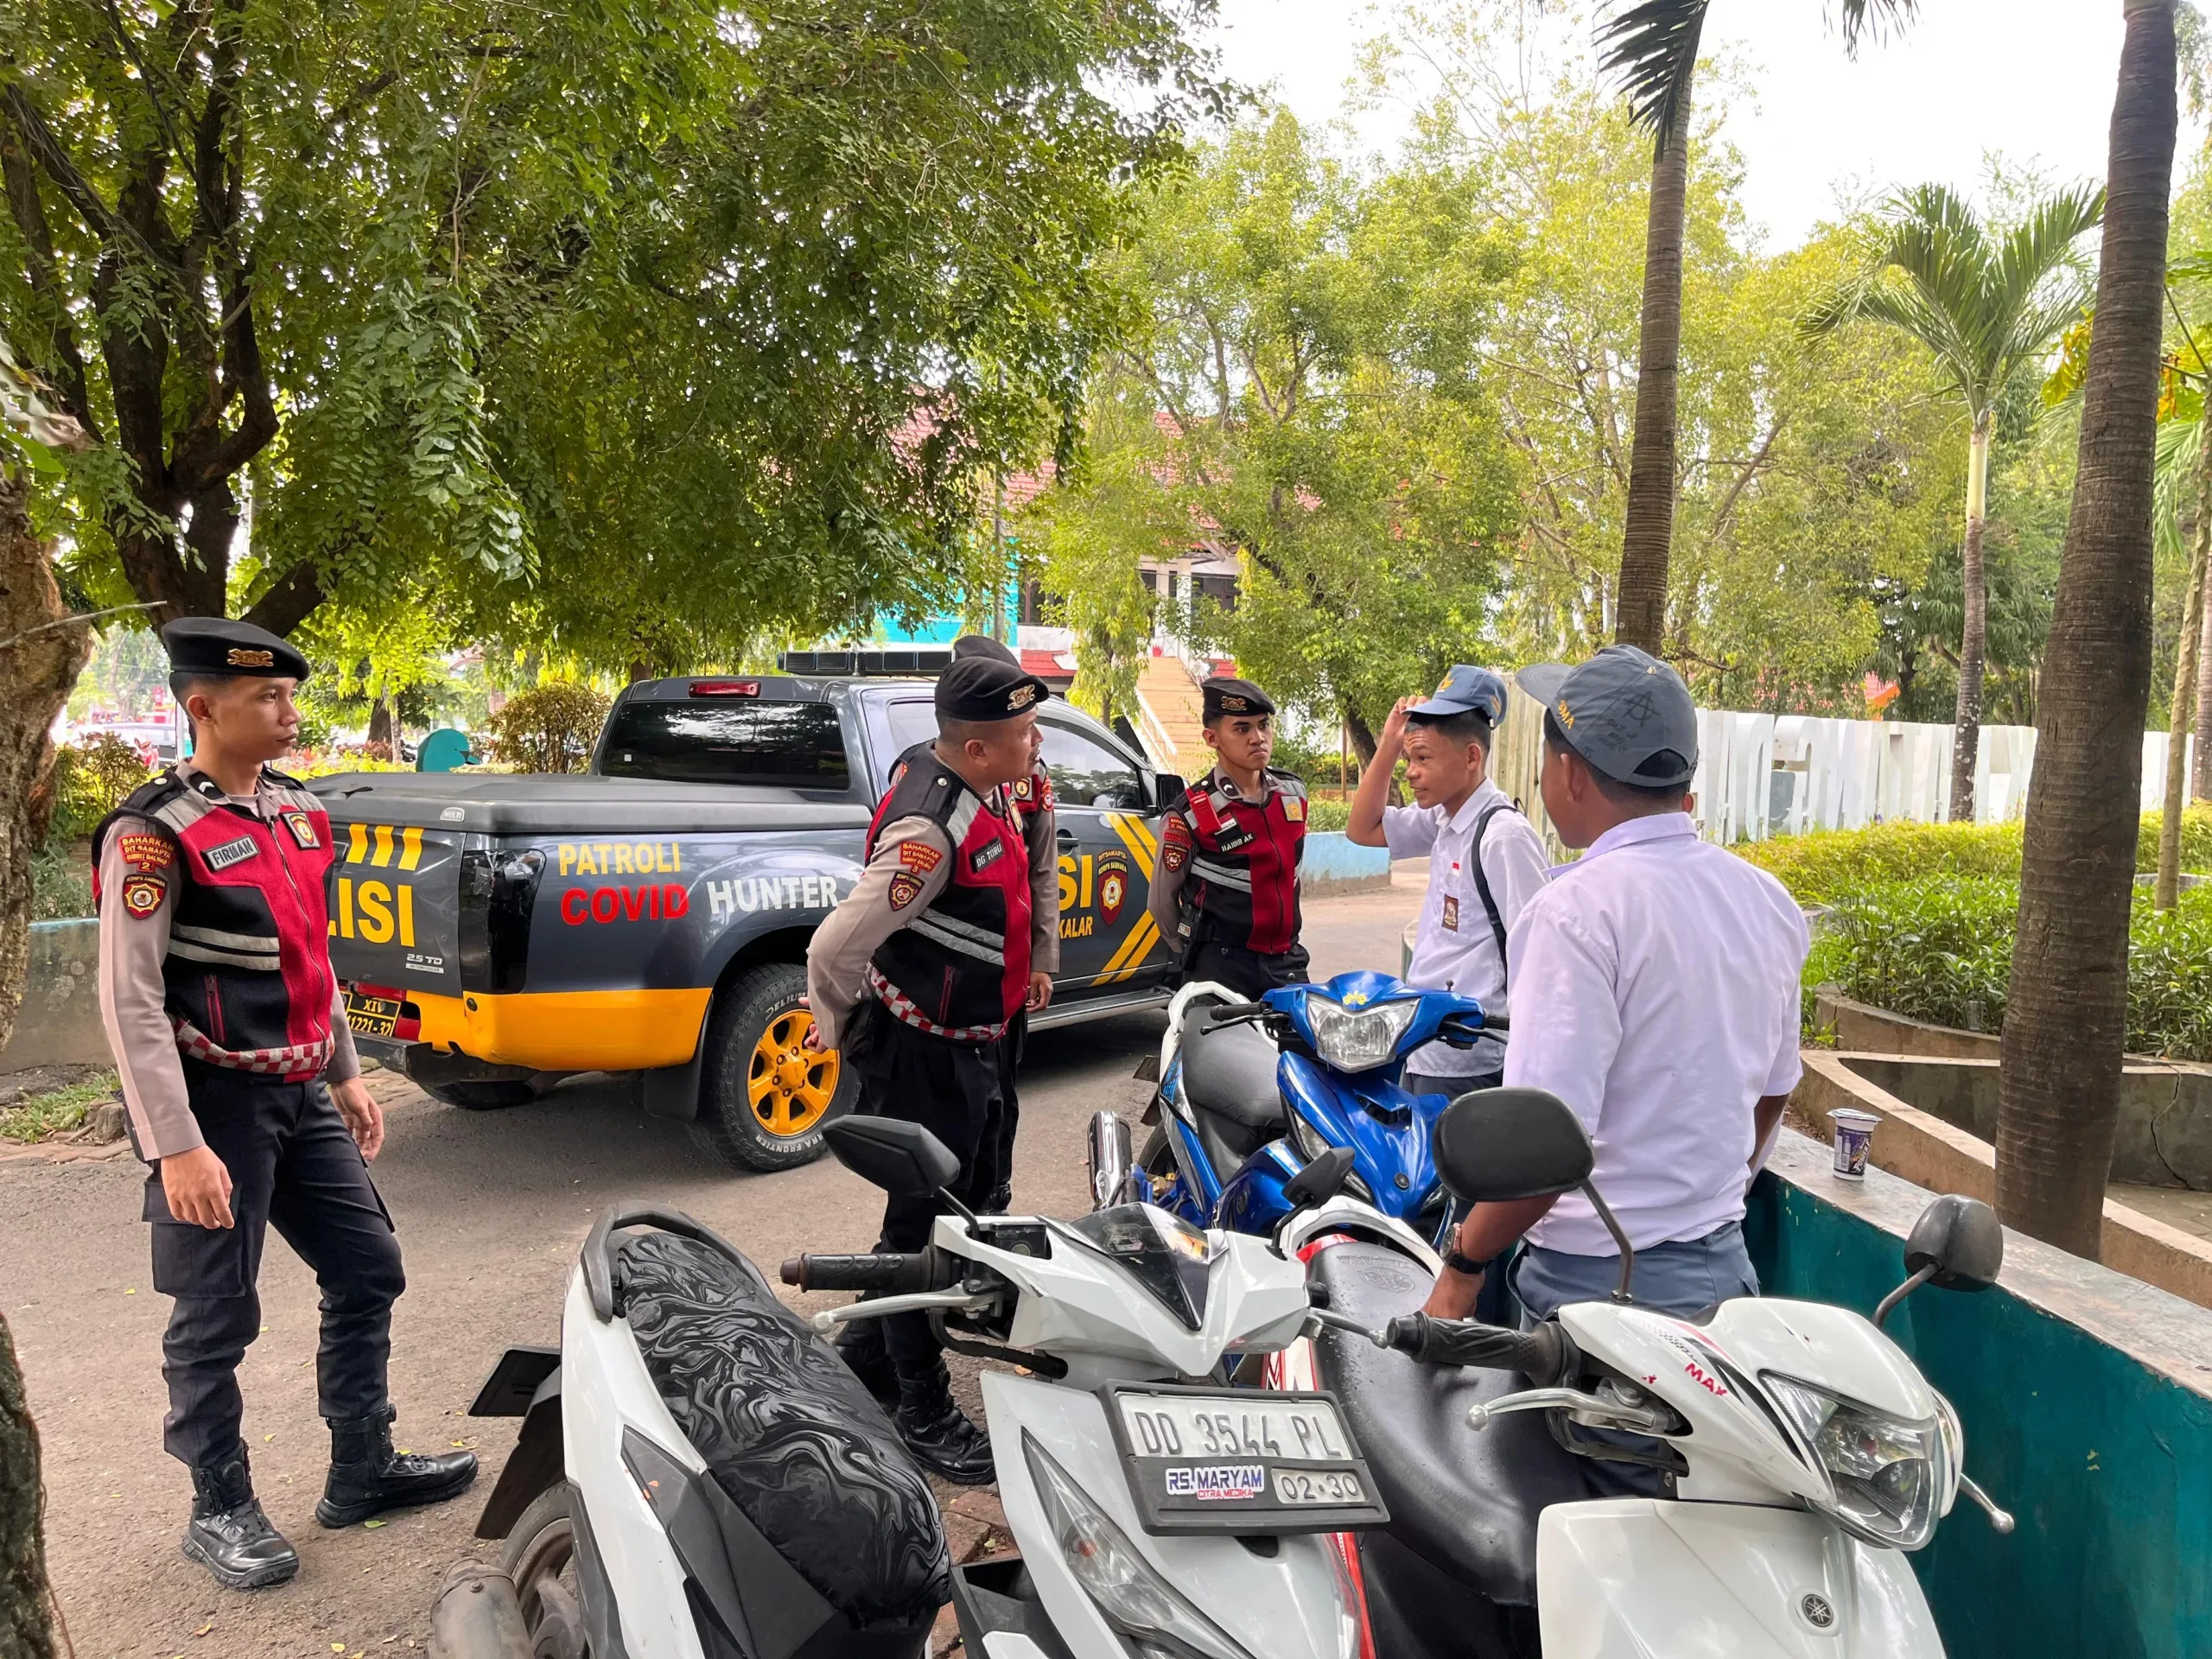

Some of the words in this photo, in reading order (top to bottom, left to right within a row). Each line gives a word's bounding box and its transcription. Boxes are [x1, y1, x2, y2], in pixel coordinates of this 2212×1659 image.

[1558, 699, 1575, 730] SMA
[1243, 832, 1254, 843] AK
[212, 839, 255, 867] FIRMAN
[557, 842, 681, 876] PATROLI
[976, 856, 986, 868] DG
[142, 861, 150, 870] 2
[560, 883, 690, 925] COVID
[706, 876, 838, 914] HUNTER
[1058, 916, 1093, 939] KALAR
[425, 955, 442, 965] TD
[755, 1134, 802, 1154] FRONTIER
[1684, 1363, 1727, 1396] MAX
[1134, 1411, 1183, 1455] DD
[1195, 1414, 1282, 1456] 3544
[1290, 1414, 1343, 1457] PL
[1197, 1468, 1263, 1490] MARYAM
[1198, 1488, 1223, 1498] CITRA
[1223, 1488, 1254, 1498] MEDIKA
